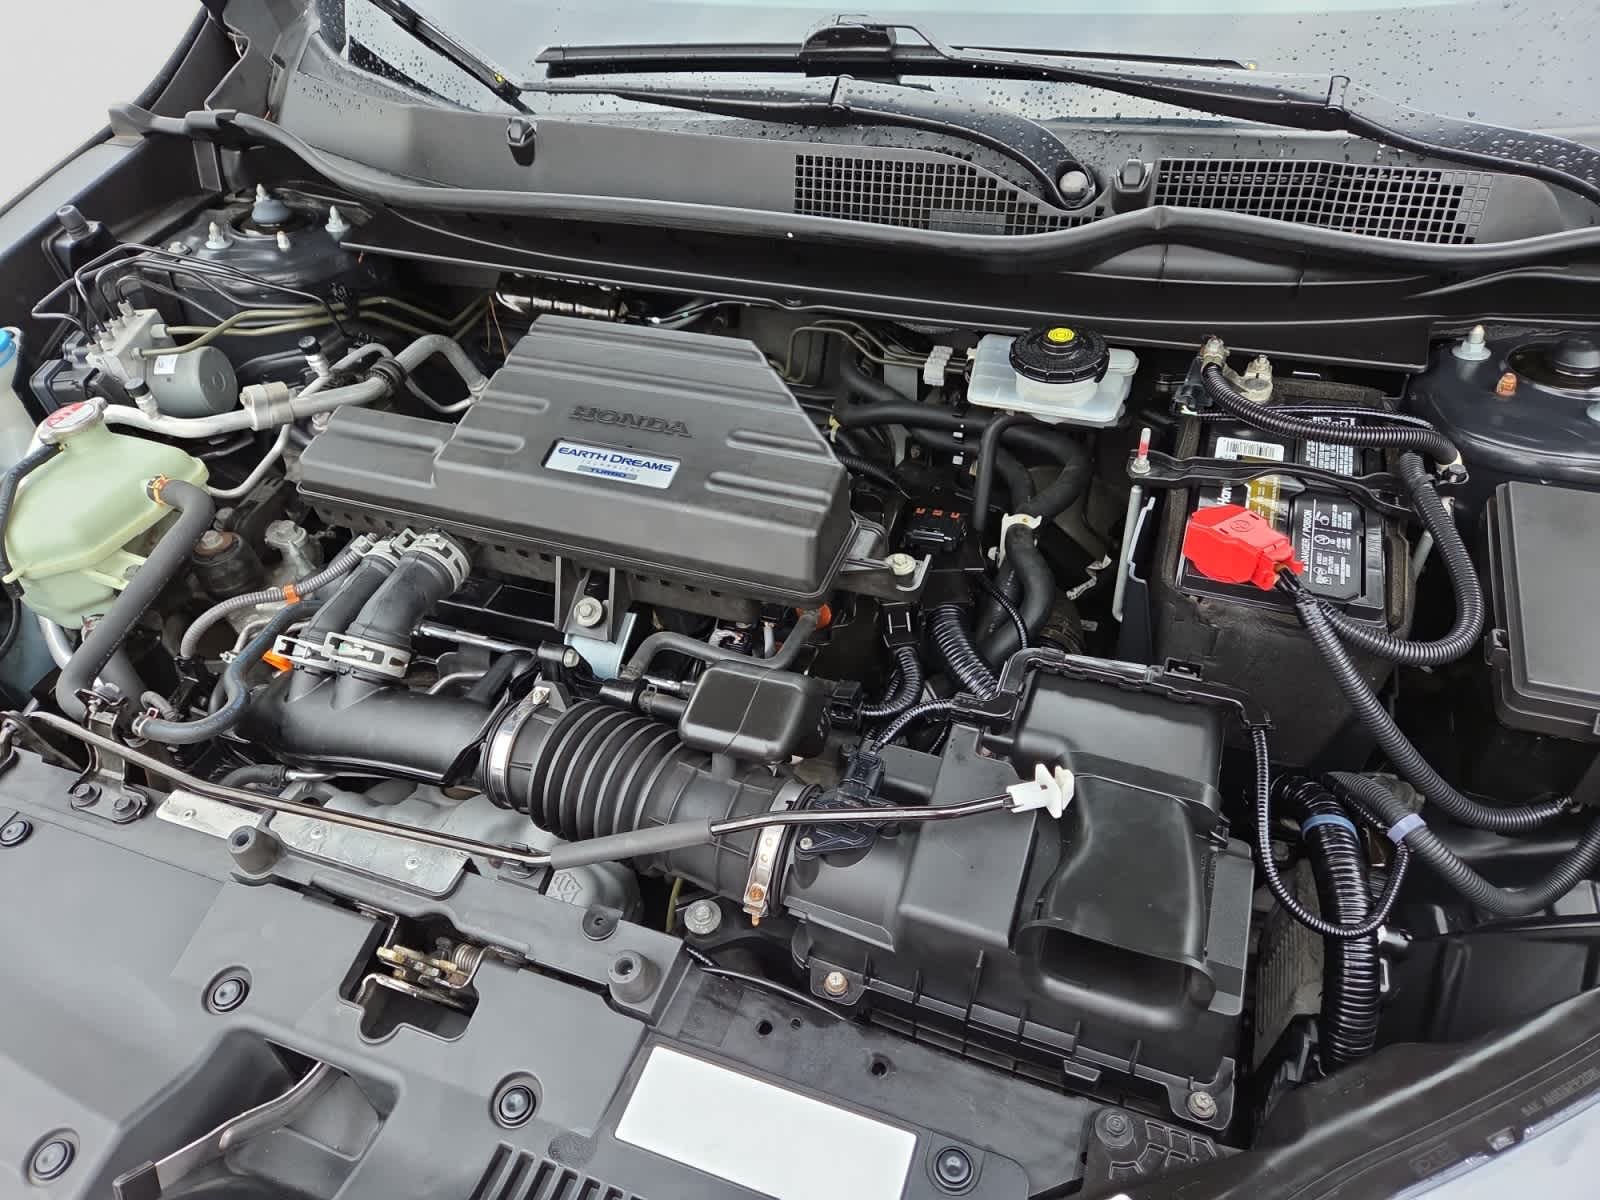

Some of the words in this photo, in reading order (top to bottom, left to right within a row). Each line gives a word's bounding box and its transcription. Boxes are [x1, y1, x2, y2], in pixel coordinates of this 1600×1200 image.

[569, 406, 692, 438] HONDA
[558, 447, 608, 462] EARTH
[609, 454, 673, 472] DREAMS
[590, 467, 627, 479] TURBO
